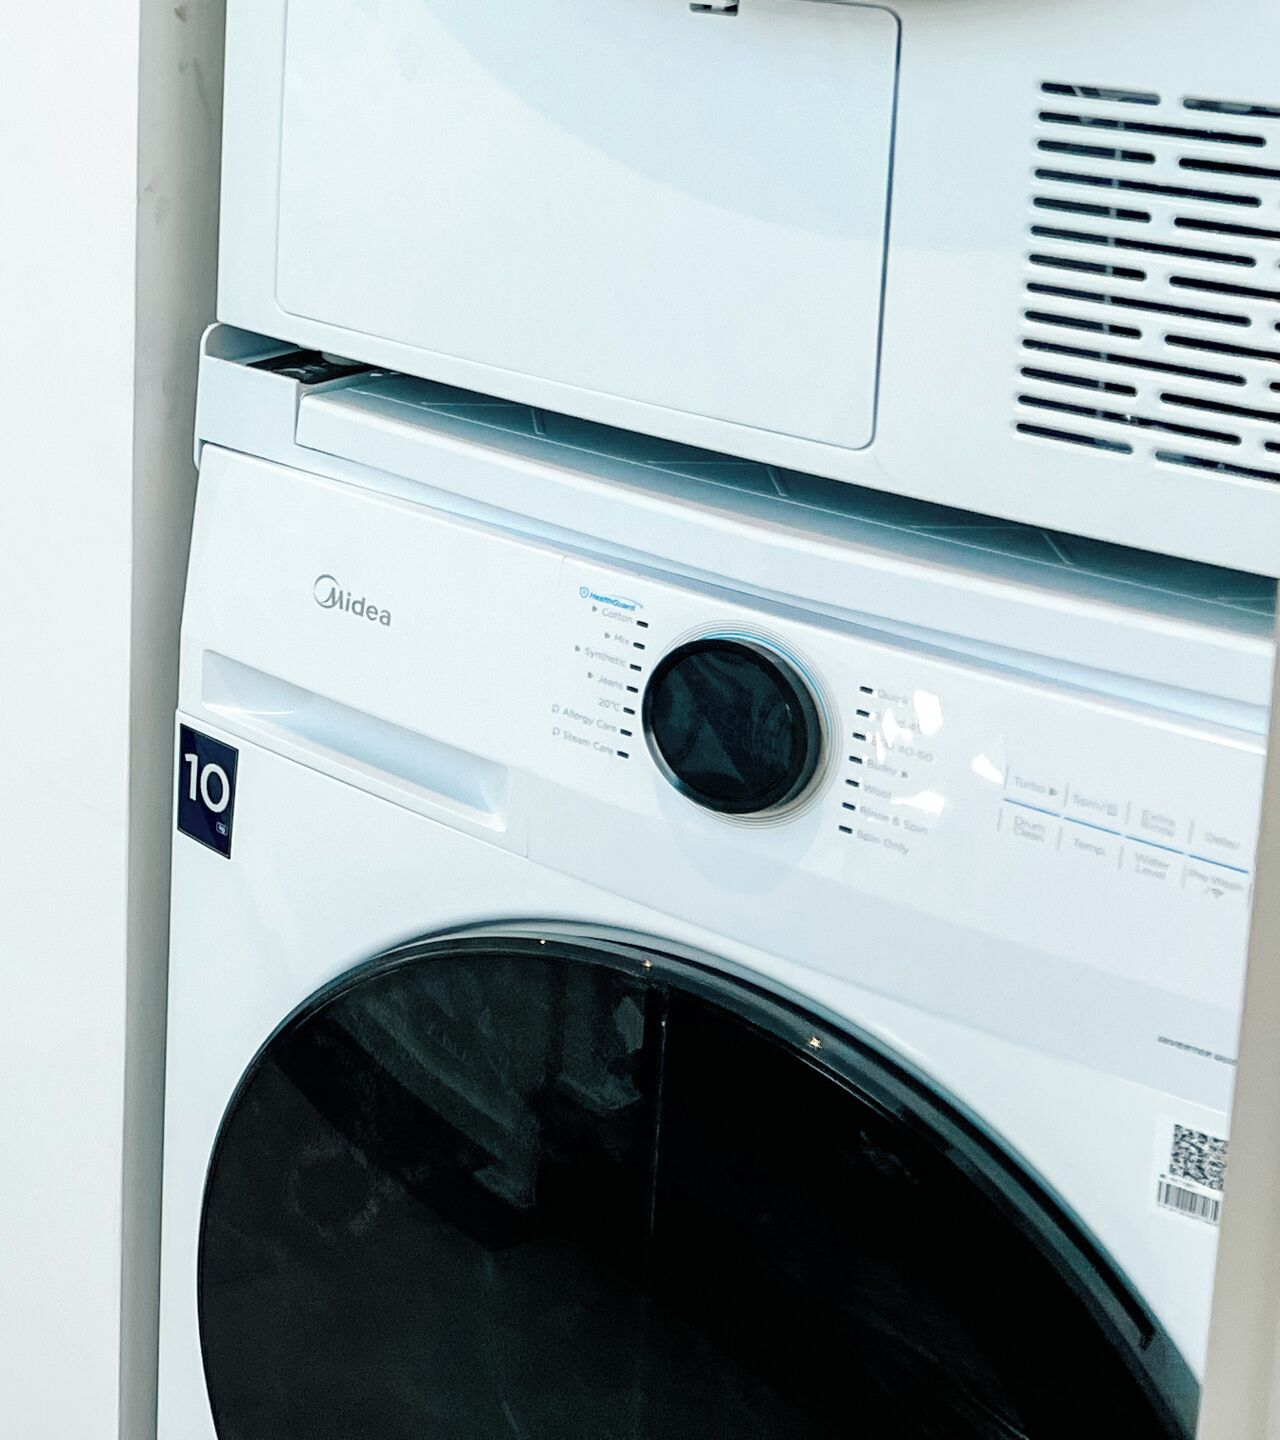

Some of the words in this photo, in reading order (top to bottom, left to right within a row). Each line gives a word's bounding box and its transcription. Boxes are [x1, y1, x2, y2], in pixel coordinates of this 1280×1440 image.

[313, 573, 392, 627] Midea
[601, 607, 634, 624] Cotton
[584, 647, 627, 668] Synthetic
[562, 707, 594, 726] Allergy
[596, 719, 618, 733] Care
[562, 730, 591, 746] Steam
[592, 741, 615, 756] Care
[184, 753, 230, 813] 10
[1014, 775, 1046, 794] Turbo
[1014, 815, 1046, 833] Drum
[857, 829, 880, 845] Spin
[883, 838, 910, 855] Only
